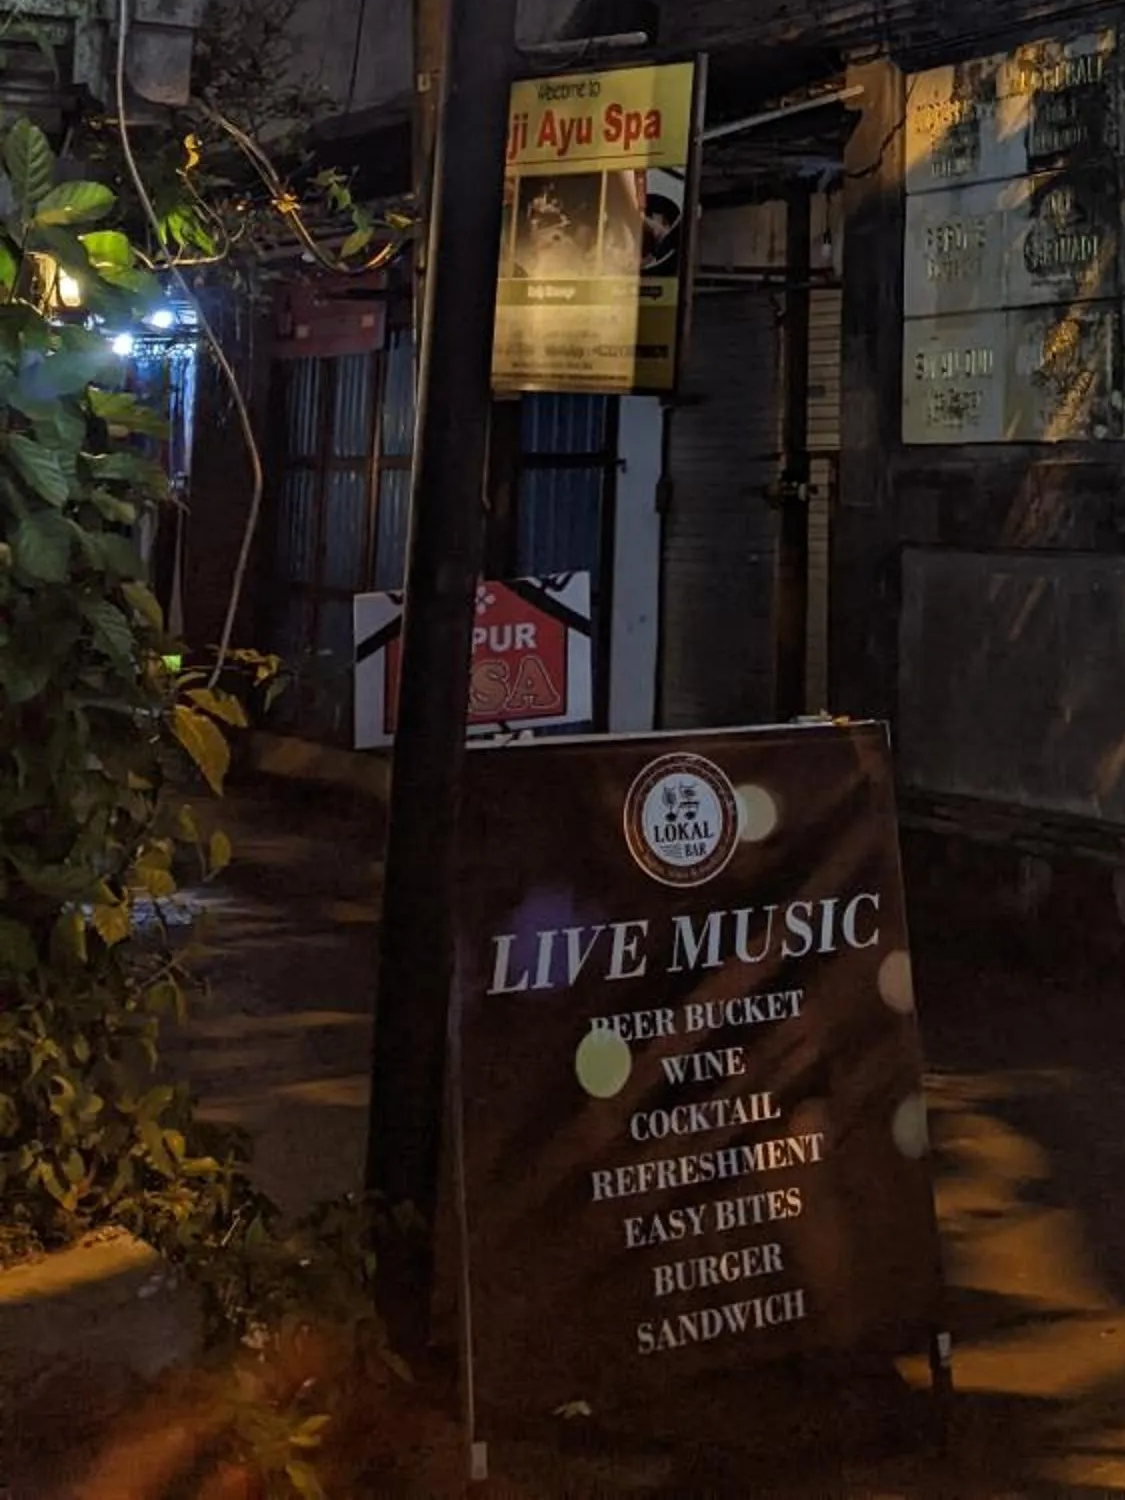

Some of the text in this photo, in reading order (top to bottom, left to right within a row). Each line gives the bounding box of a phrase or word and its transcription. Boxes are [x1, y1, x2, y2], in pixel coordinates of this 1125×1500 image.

[536, 109, 593, 157] Ayu
[603, 102, 662, 151] Spa
[653, 820, 715, 843] LOKAL
[685, 842, 707, 858] BAR
[486, 892, 882, 996] LIVE MUSIC
[684, 990, 804, 1036] BUCKET
[661, 1047, 746, 1085] WINE
[630, 1091, 782, 1141] COCKTAIL
[590, 1132, 825, 1201] REFRESHMENT
[624, 1187, 804, 1250] EASY BITES
[653, 1242, 784, 1297] BURGER
[636, 1288, 806, 1355] SANDWICH
